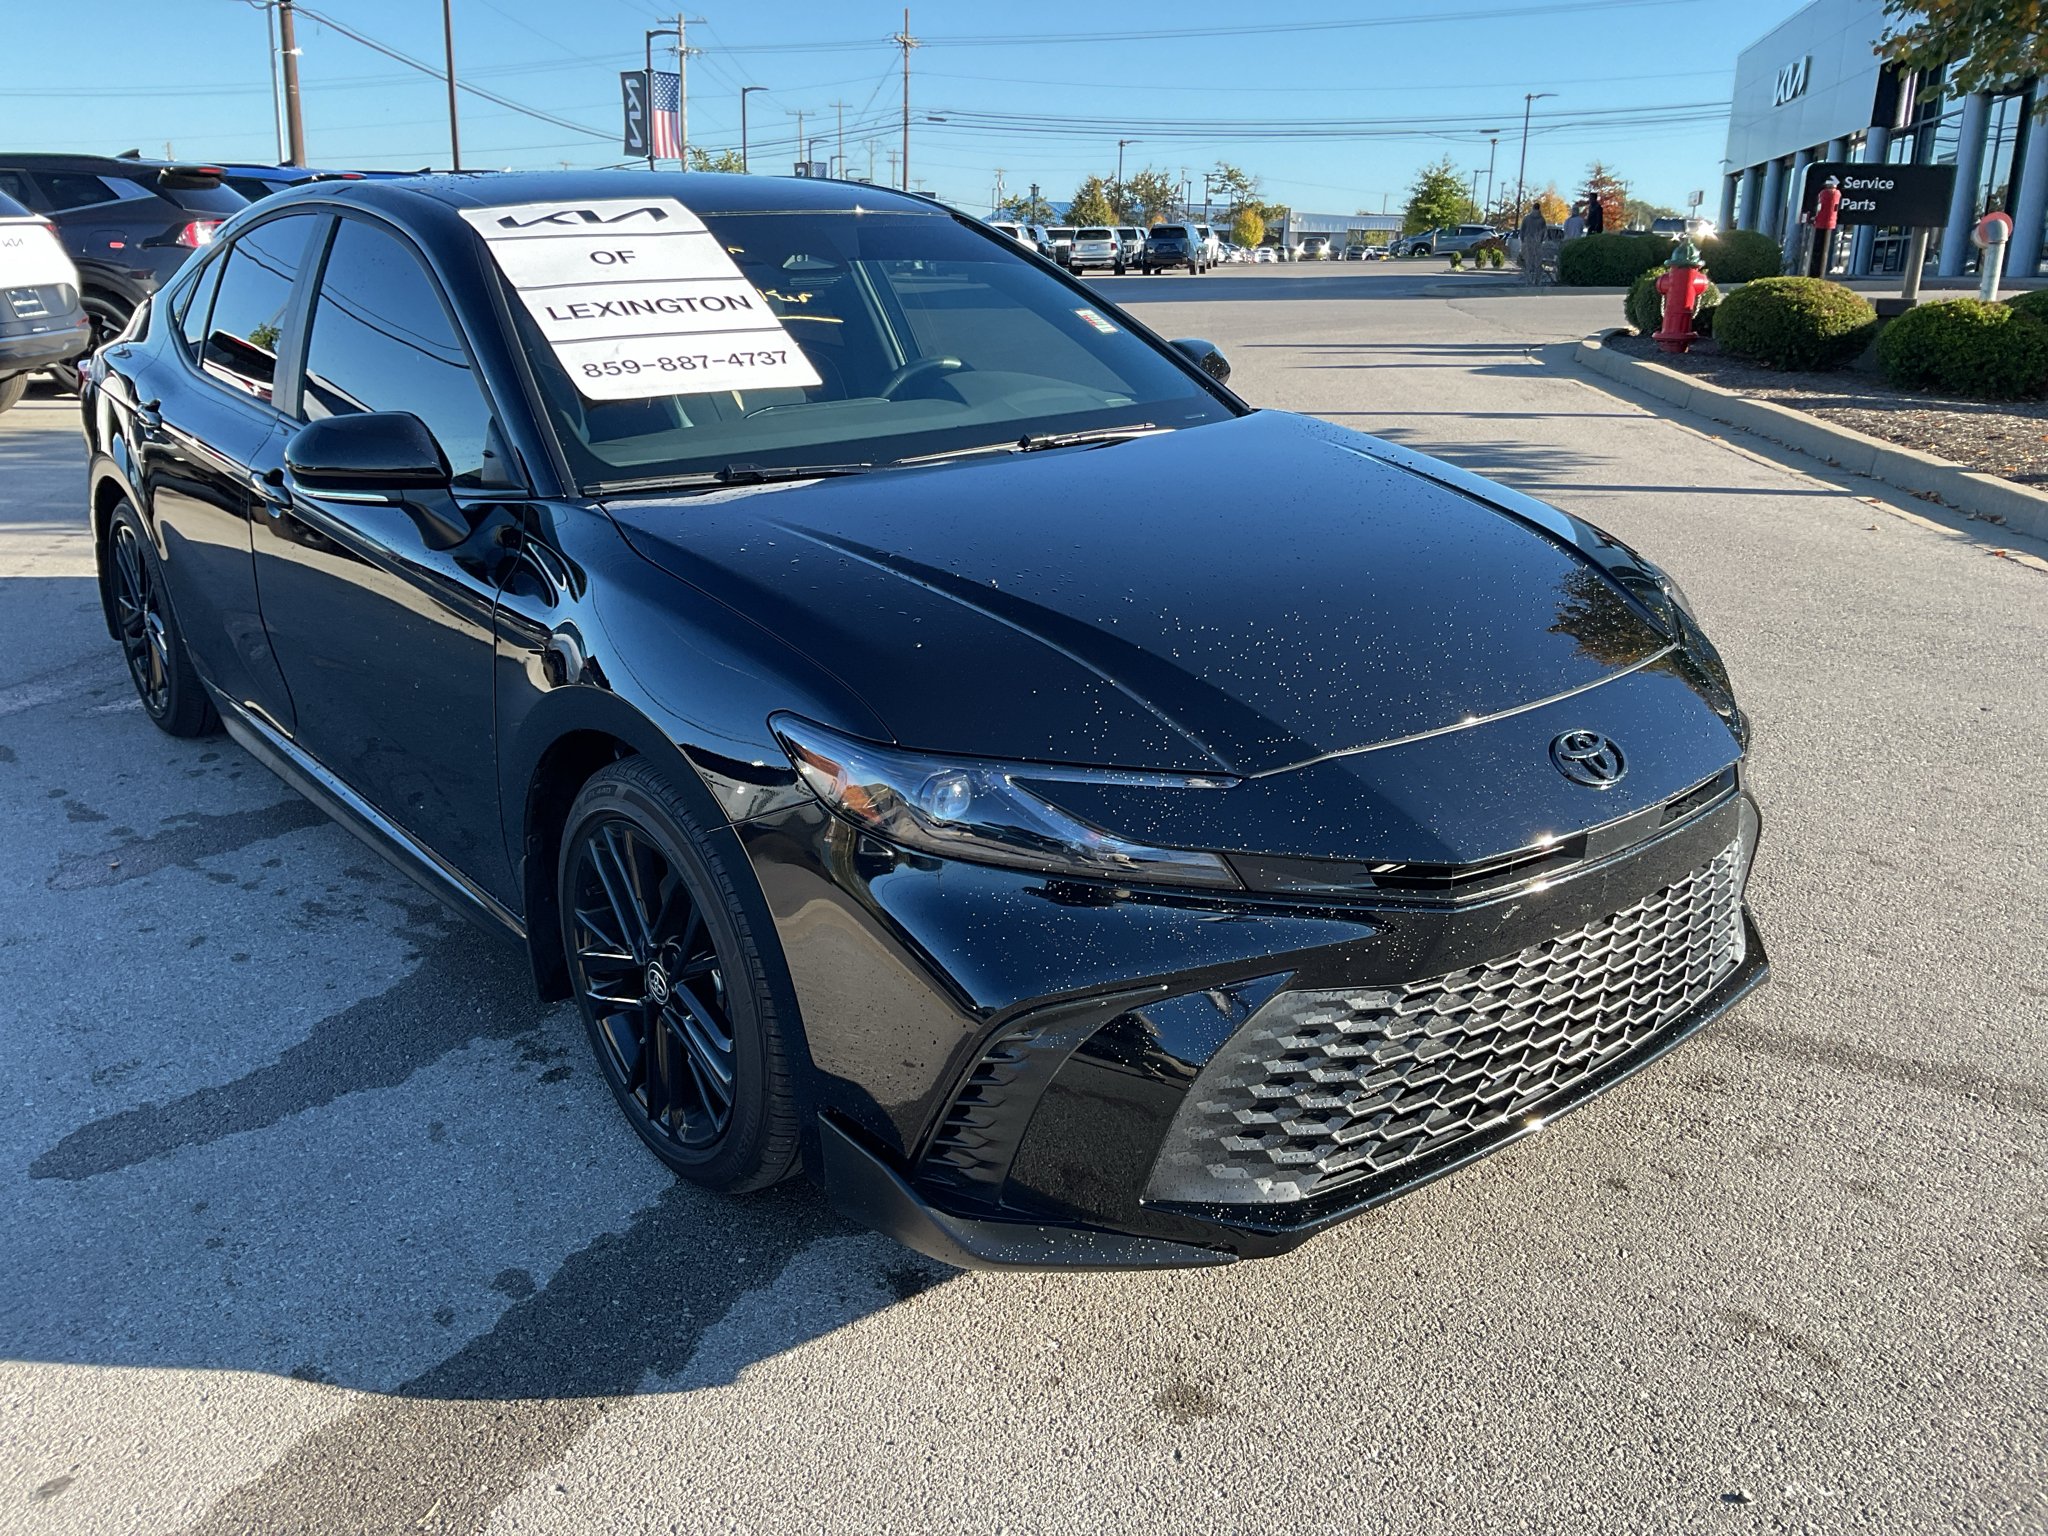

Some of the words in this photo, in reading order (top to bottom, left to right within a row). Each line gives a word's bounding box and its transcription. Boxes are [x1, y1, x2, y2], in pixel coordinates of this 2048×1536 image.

[1772, 56, 1808, 106] KIA
[1843, 176, 1894, 190] Service
[1840, 197, 1876, 211] Parts
[496, 207, 669, 229] KIA
[590, 249, 636, 266] OF
[545, 294, 754, 322] LEXINGTON
[582, 350, 788, 378] 859-887-4737
